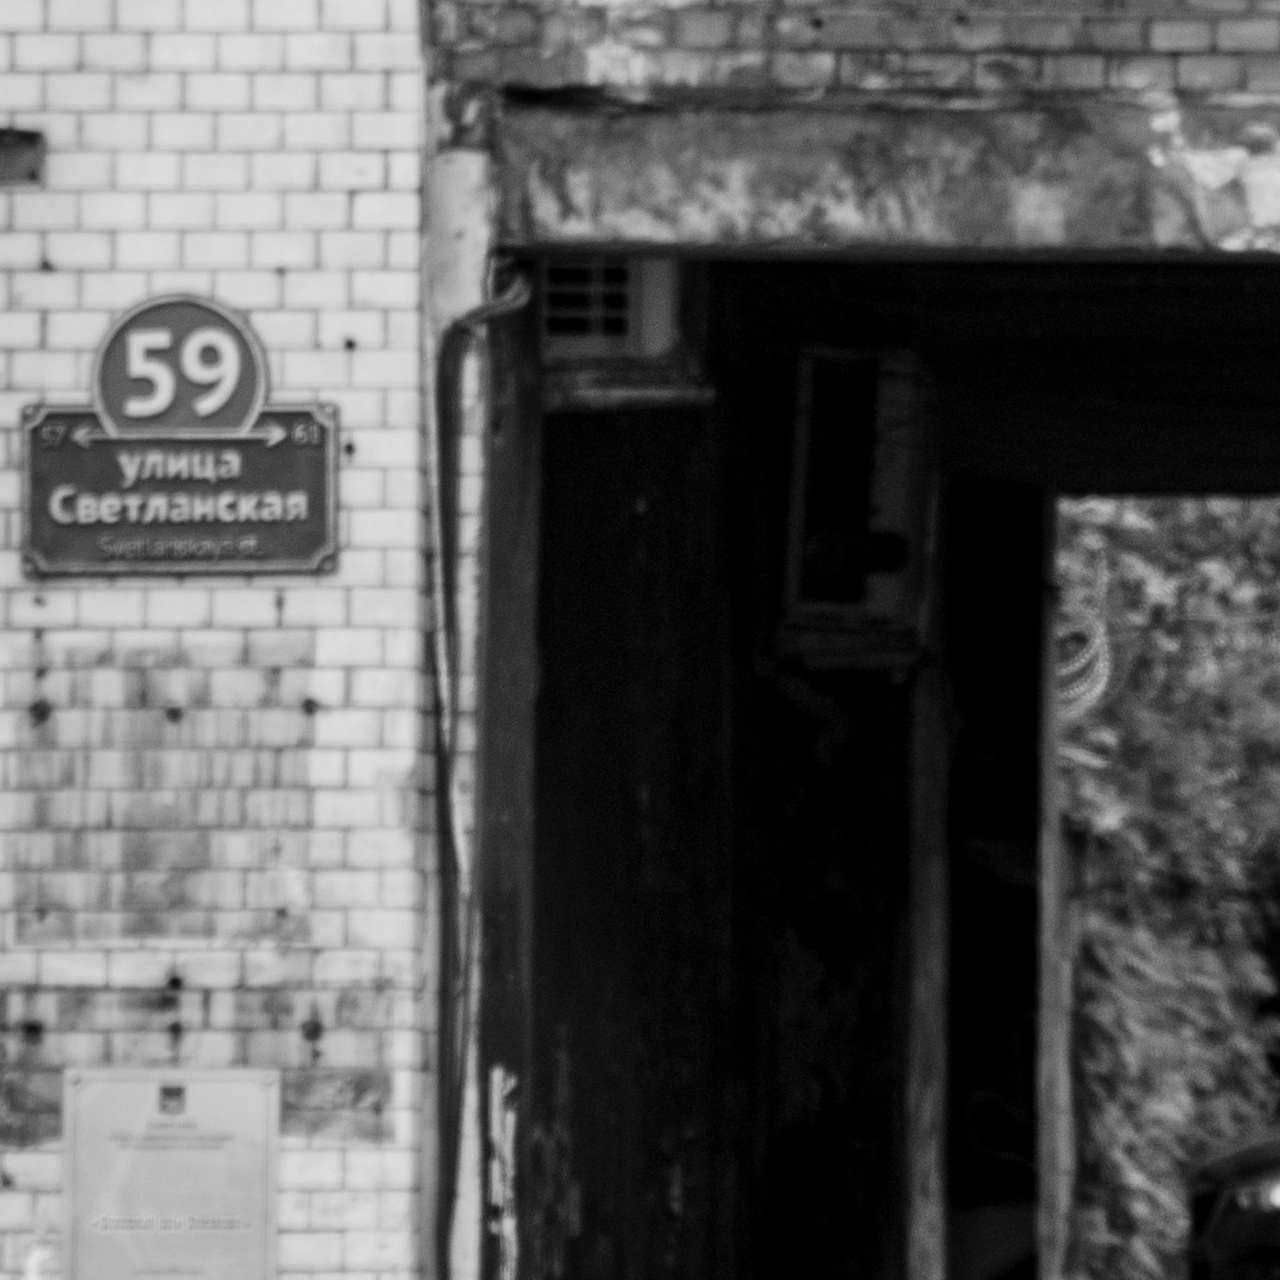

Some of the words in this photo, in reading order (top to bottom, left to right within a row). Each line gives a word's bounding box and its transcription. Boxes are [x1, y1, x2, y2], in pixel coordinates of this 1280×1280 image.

[123, 326, 242, 418] 59
[291, 422, 321, 446] 61
[117, 448, 243, 489] улица
[48, 483, 310, 524] Светланская
